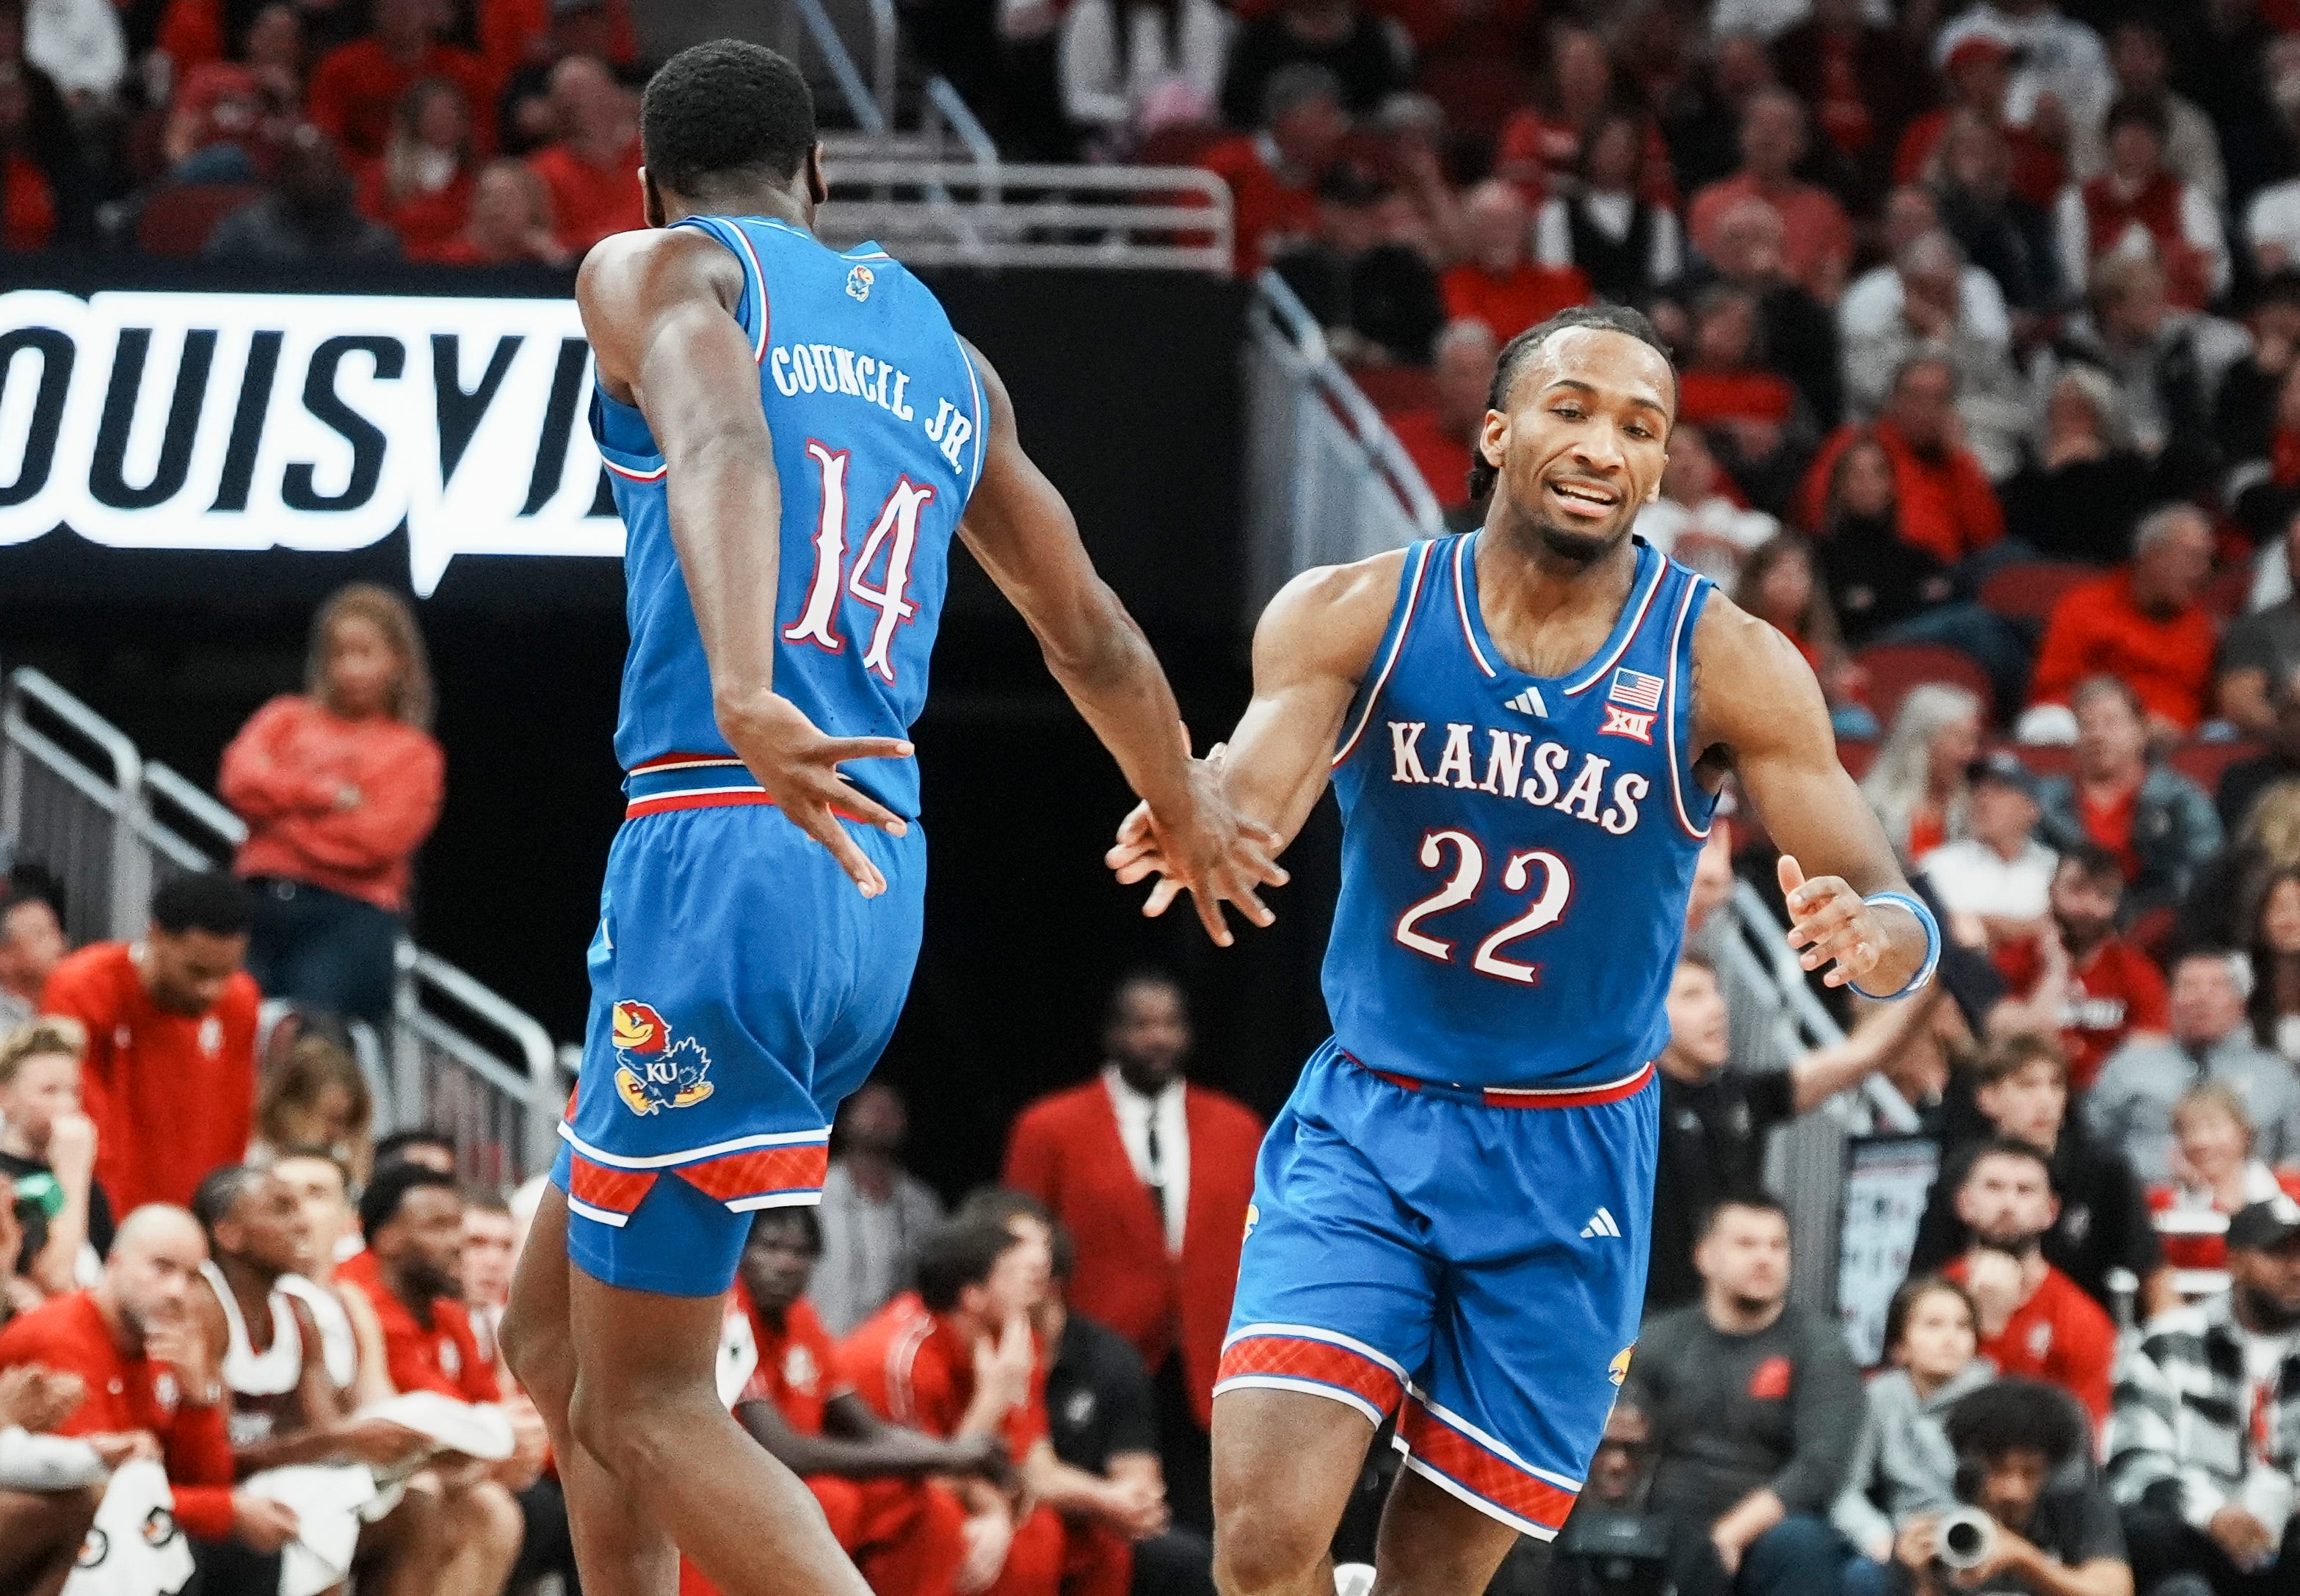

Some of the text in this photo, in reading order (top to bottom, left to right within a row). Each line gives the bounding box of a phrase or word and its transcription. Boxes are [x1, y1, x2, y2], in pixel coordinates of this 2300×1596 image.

[0, 326, 620, 518] OUISVI
[771, 344, 974, 476] COUNCIL JR.
[783, 438, 937, 685] 14
[1386, 721, 1651, 835] KANSAS
[1599, 701, 1658, 744] XII
[1395, 830, 1573, 984] 22
[644, 1062, 678, 1085] KU
